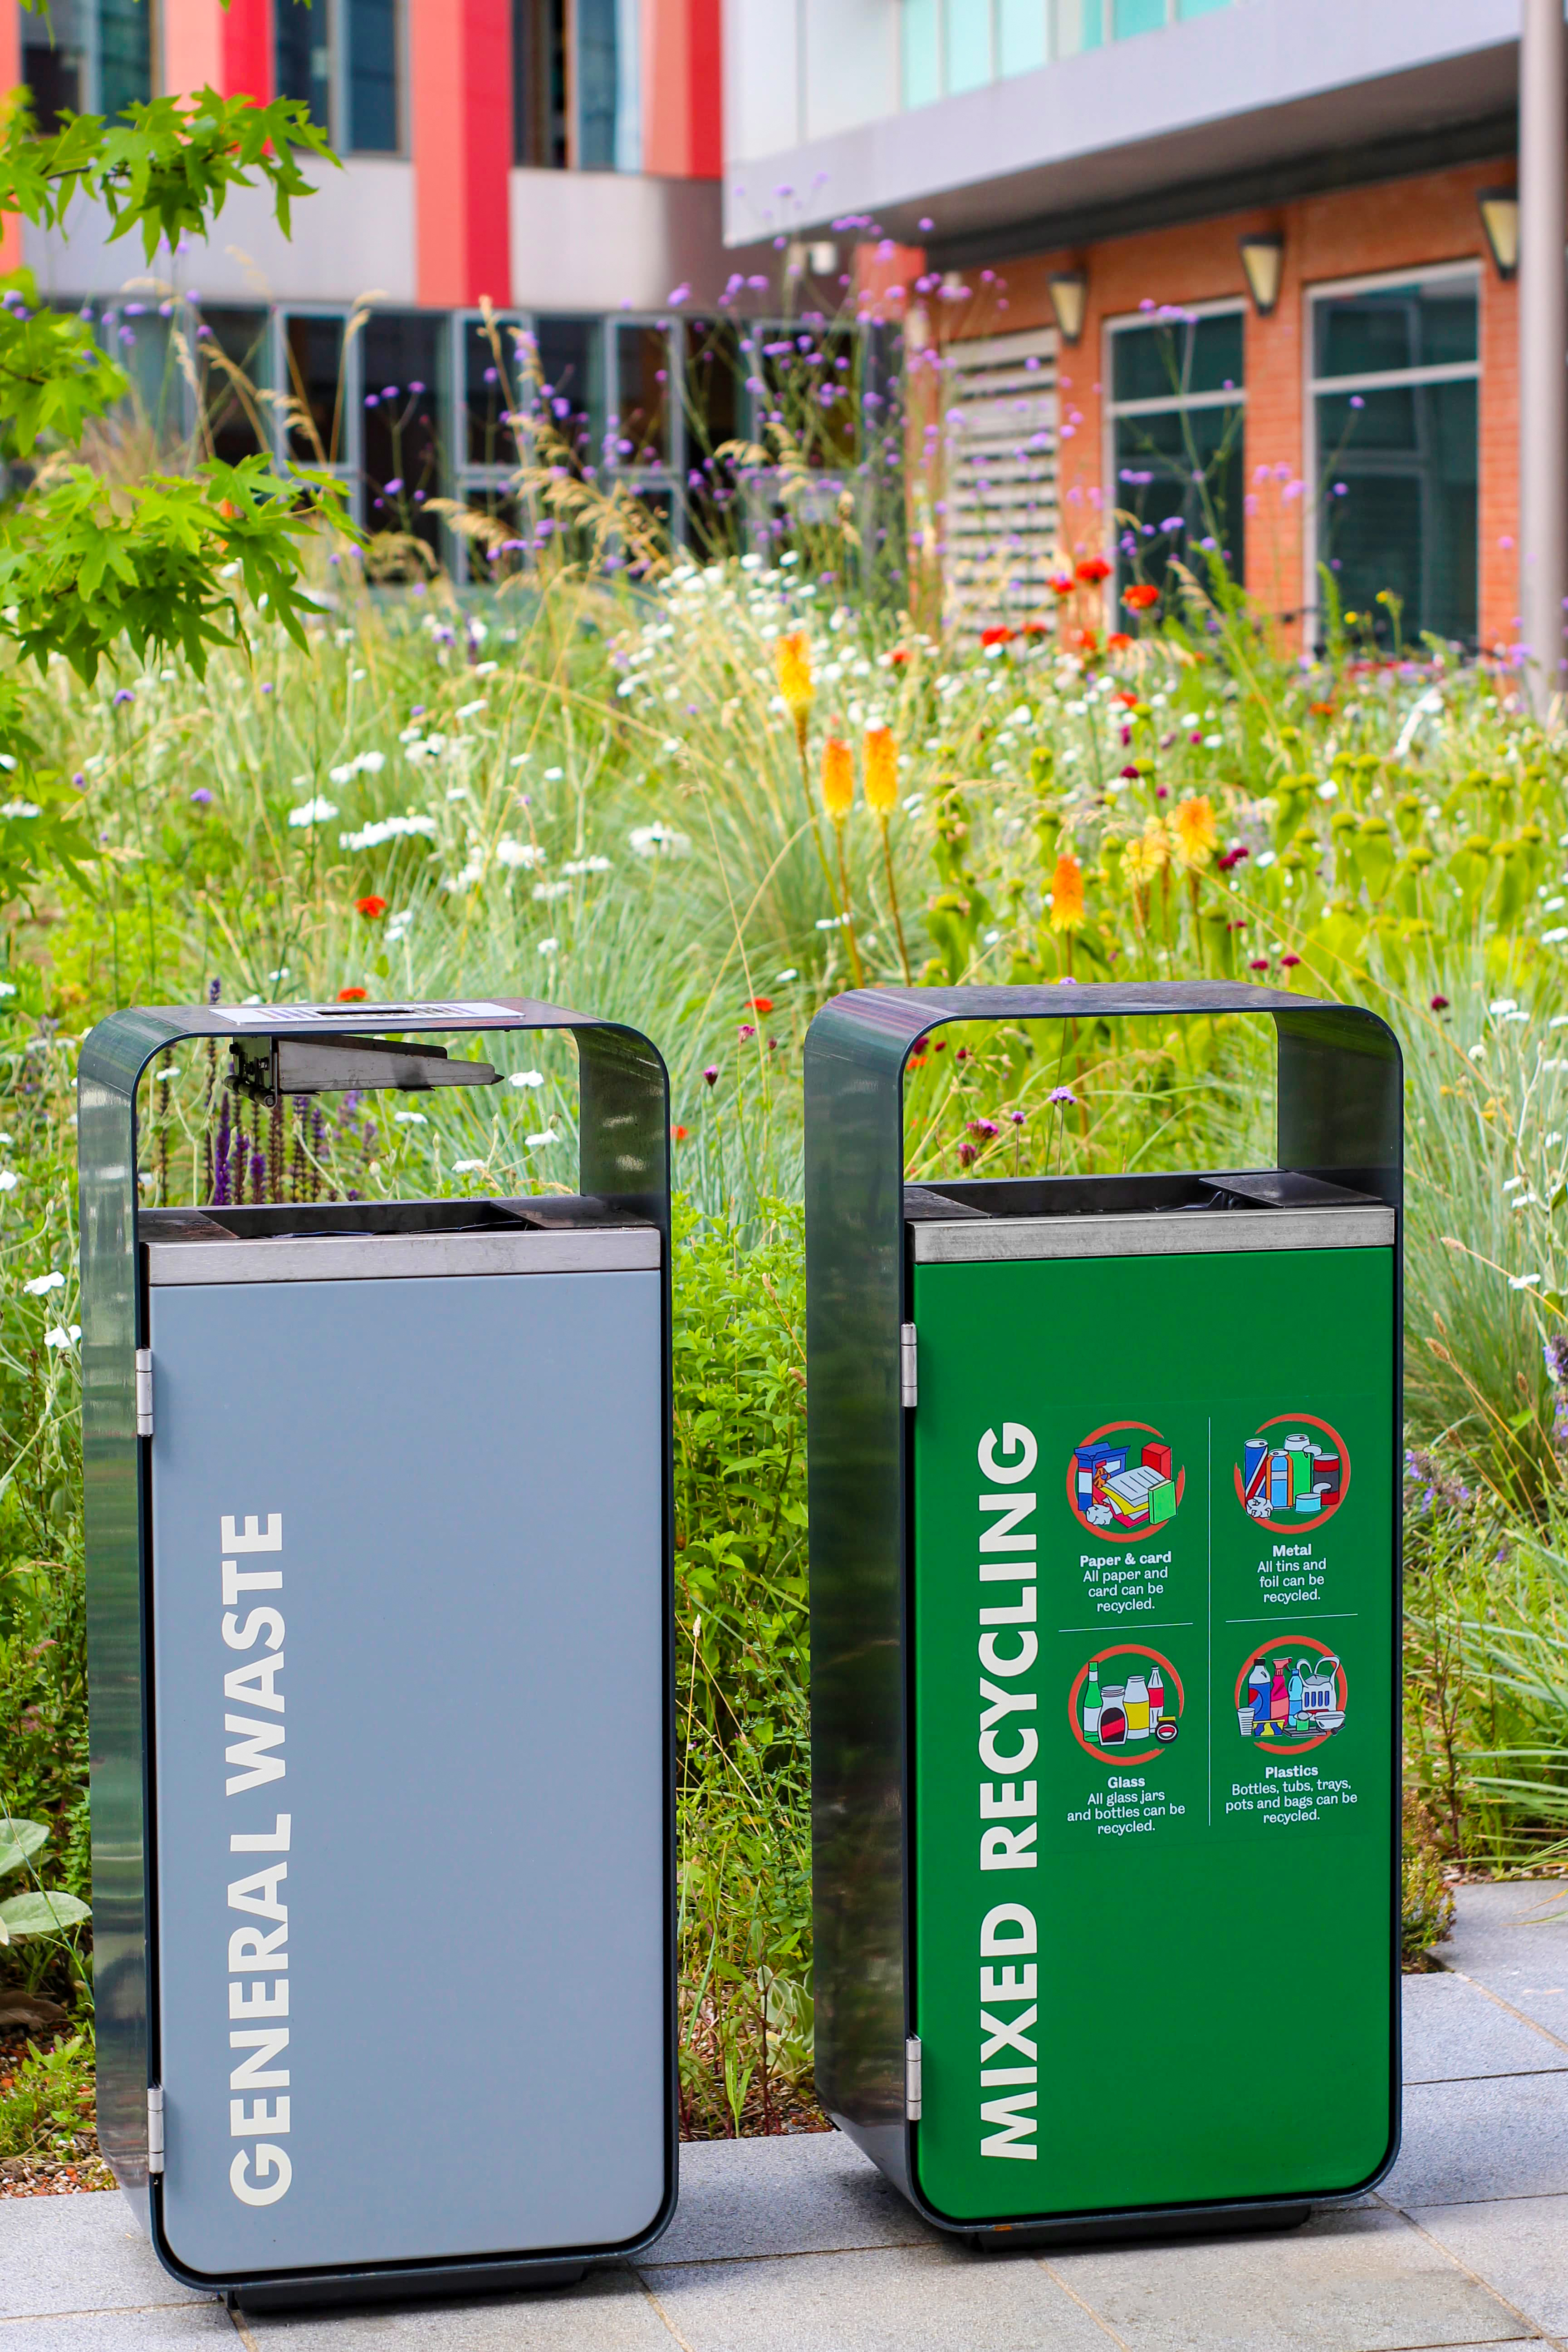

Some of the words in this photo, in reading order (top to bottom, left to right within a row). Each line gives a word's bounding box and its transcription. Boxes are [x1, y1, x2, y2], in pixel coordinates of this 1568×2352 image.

[1273, 1544, 1312, 1557] Metal
[1080, 1555, 1121, 1569] Paper
[1124, 1553, 1136, 1565] &
[1139, 1551, 1171, 1564] card
[1257, 1560, 1273, 1573] All
[1275, 1560, 1300, 1572] tins
[1303, 1558, 1326, 1571] and
[1083, 1570, 1098, 1582] All
[1102, 1571, 1141, 1584] paper
[1144, 1566, 1168, 1579] and
[1259, 1575, 1279, 1588] foil
[1283, 1577, 1305, 1587] can
[1309, 1573, 1324, 1585] be
[1088, 1584, 1117, 1597] card
[1121, 1586, 1144, 1596] can
[1148, 1582, 1164, 1594] be
[1264, 1588, 1321, 1605] recycled.
[1097, 1597, 1155, 1614] recycled.
[221, 1513, 285, 1796] WASTE
[978, 1422, 1039, 1871] RECYCLING
[1265, 1764, 1318, 1779] Plastics
[1107, 1776, 1145, 1789] Glass
[1232, 1782, 1279, 1796] Bottles,
[1282, 1780, 1313, 1793] tubs,
[1317, 1779, 1351, 1792] trays,
[1087, 1793, 1103, 1805] All
[1106, 1792, 1138, 1807] glass
[1140, 1790, 1165, 1804] jars
[1226, 1798, 1254, 1814] pots
[1257, 1796, 1280, 1809] and
[1284, 1795, 1313, 1809] bags
[1316, 1795, 1338, 1805] can
[1342, 1792, 1357, 1803] be
[1067, 1808, 1091, 1822] and
[1095, 1806, 1140, 1819] bottles
[1143, 1807, 1166, 1817] can
[1170, 1803, 1186, 1814] be
[1264, 1808, 1320, 1825] recycled.
[1098, 1819, 1155, 1836] recycled.
[227, 1814, 292, 2206] GENERAL
[980, 1903, 1038, 2161] MIXED
